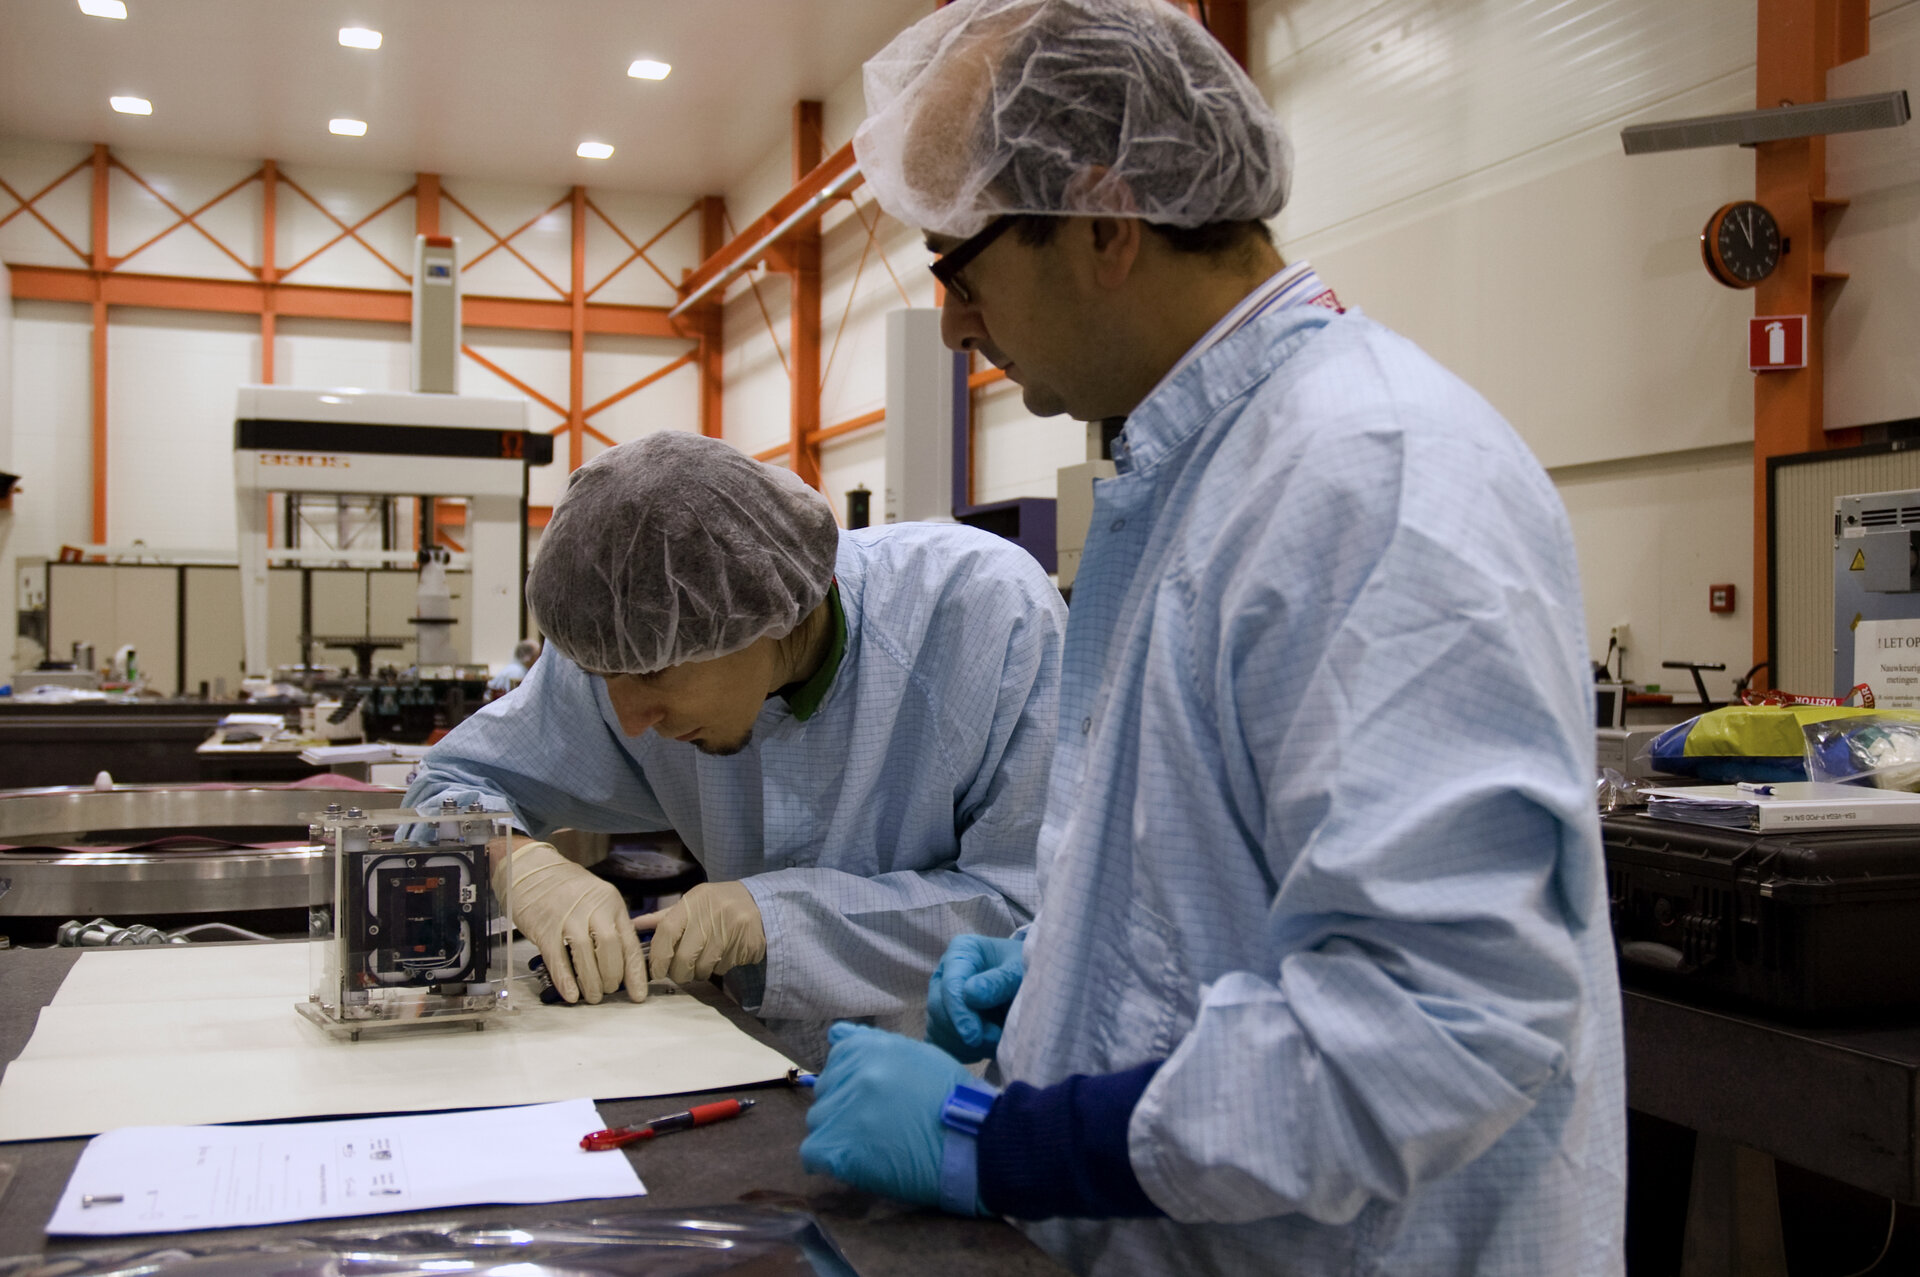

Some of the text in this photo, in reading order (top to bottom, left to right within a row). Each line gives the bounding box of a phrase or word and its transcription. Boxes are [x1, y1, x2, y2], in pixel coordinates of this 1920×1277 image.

[1884, 637, 1904, 649] LET
[1905, 636, 1920, 648] OP
[1794, 696, 1838, 707] VISITOR
[1861, 686, 1874, 708] TOR
